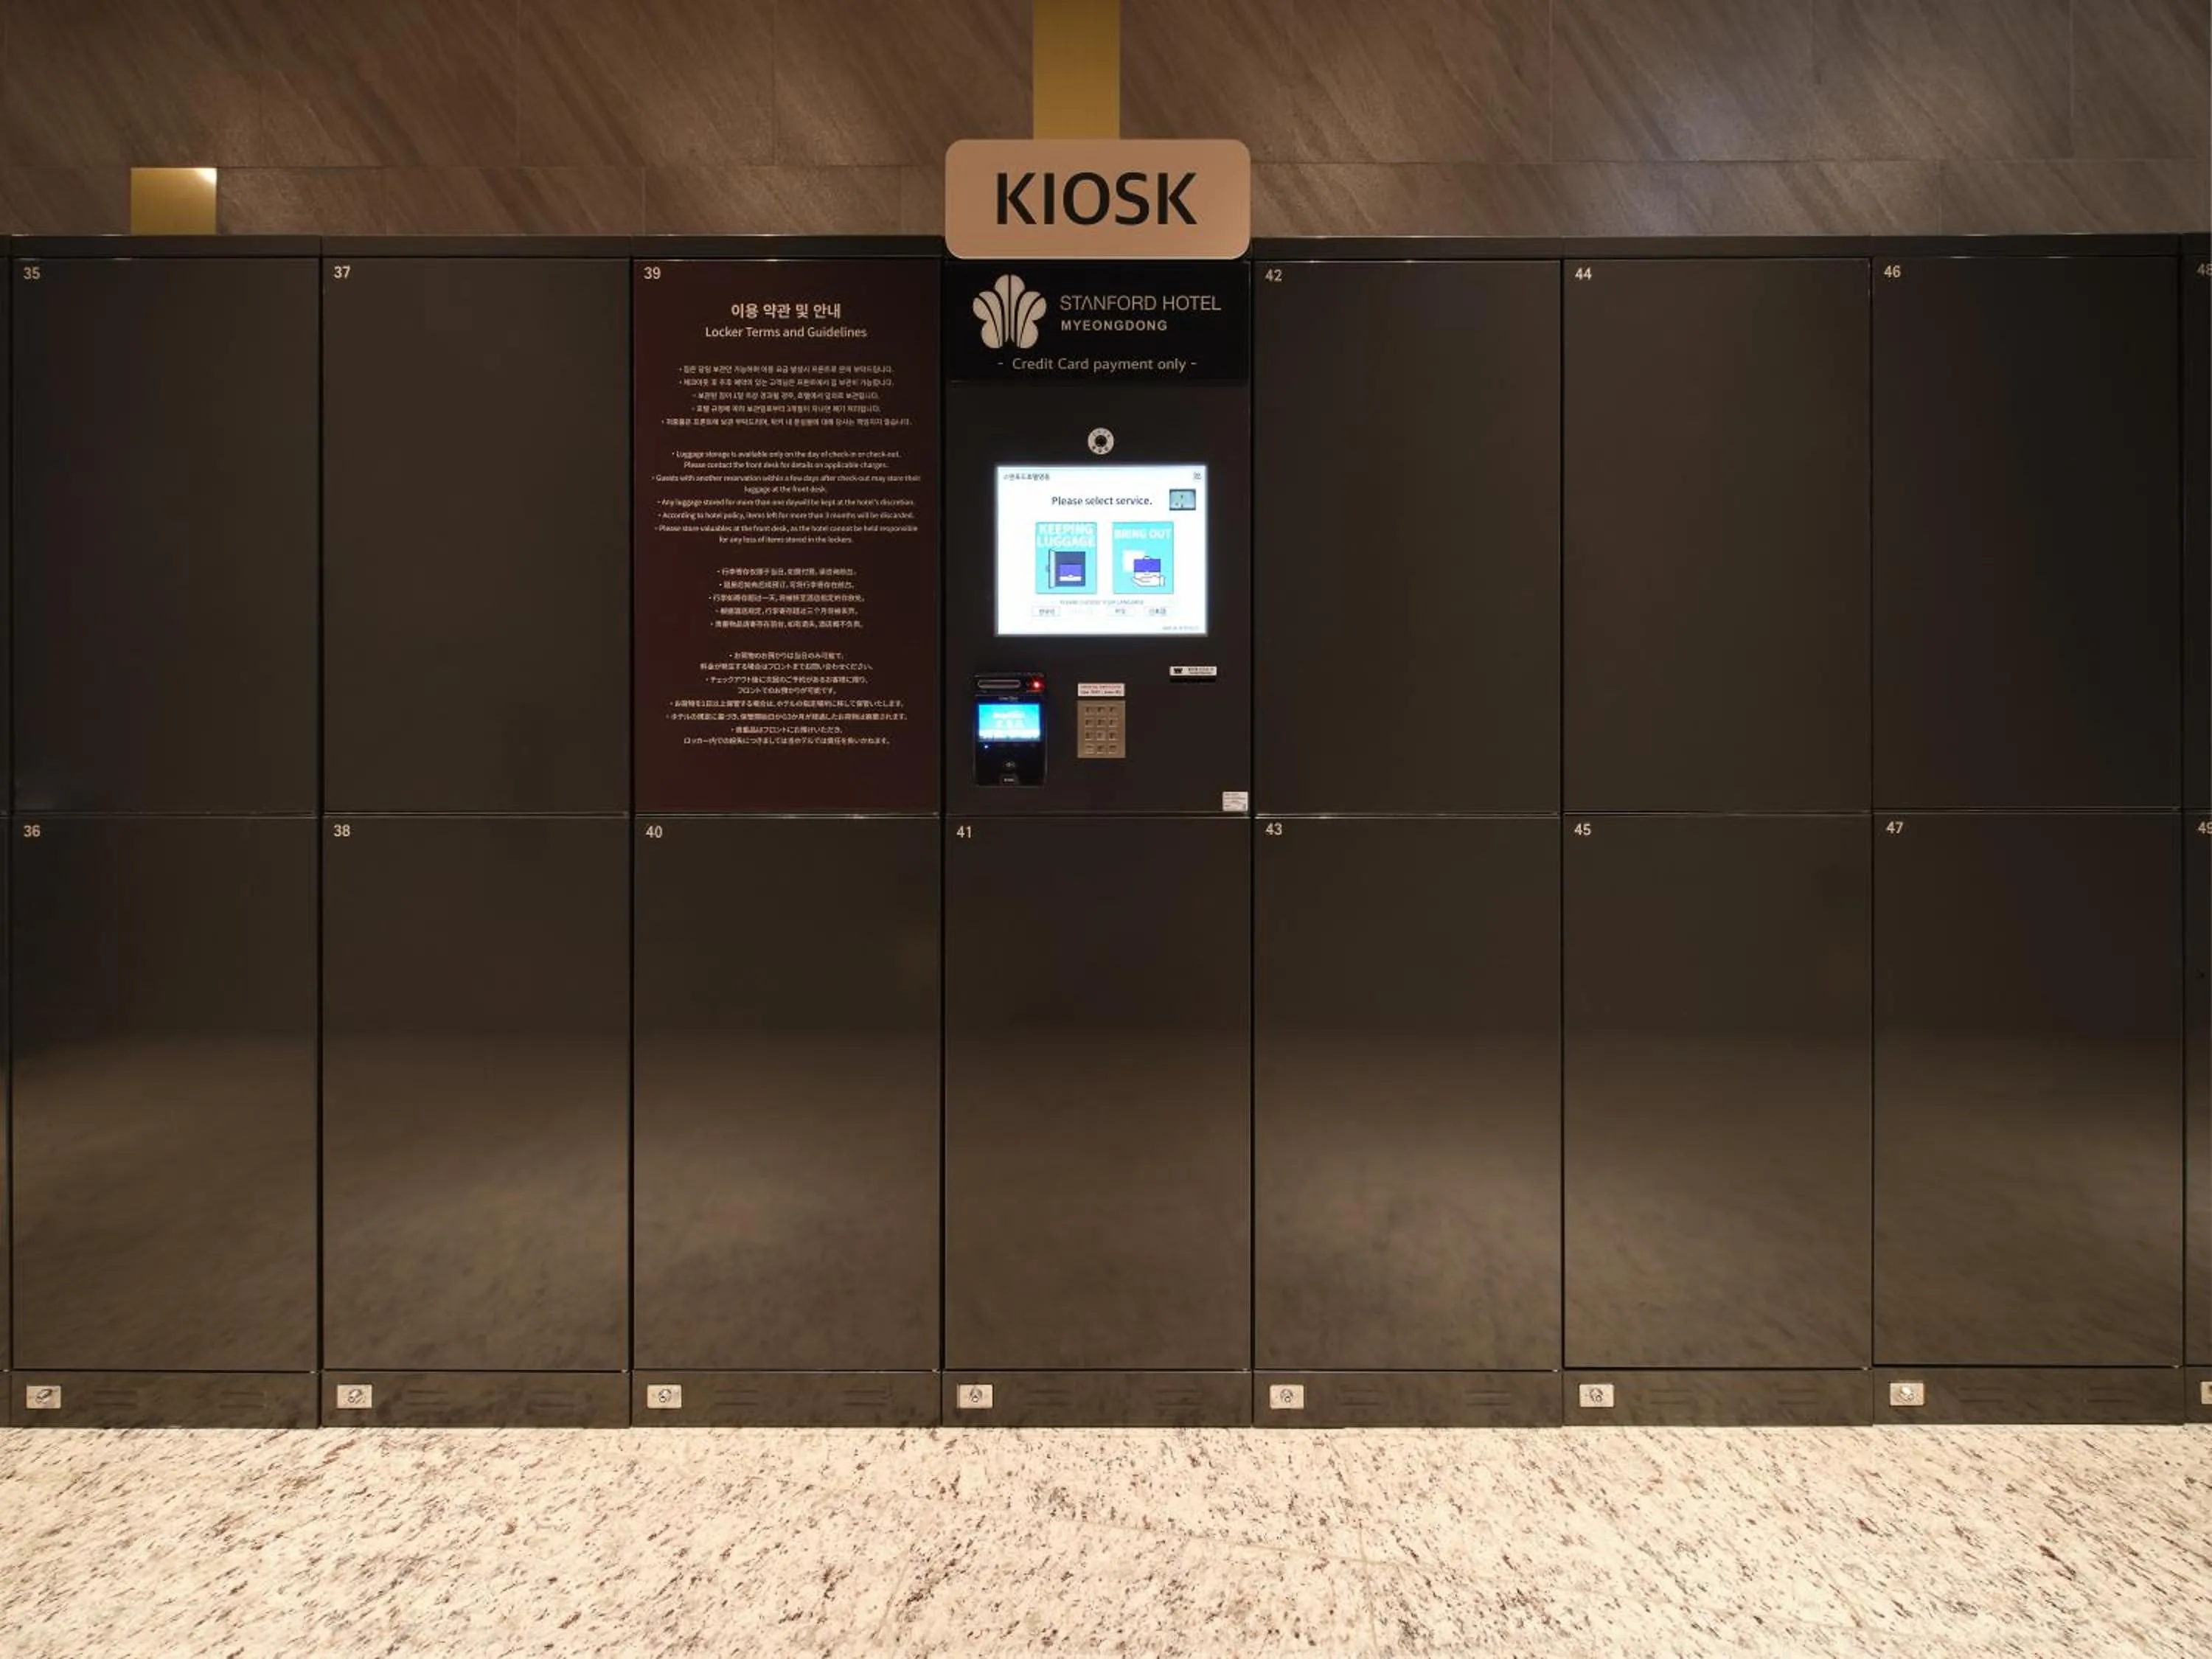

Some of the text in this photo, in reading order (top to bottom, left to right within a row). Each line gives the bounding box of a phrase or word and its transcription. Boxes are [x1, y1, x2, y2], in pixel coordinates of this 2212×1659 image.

[996, 172, 1197, 225] KIOSK
[23, 266, 41, 280] 35
[333, 265, 351, 279] 37
[643, 266, 661, 280] 39
[1265, 268, 1282, 282] 42
[1574, 267, 1593, 281] 44
[1883, 265, 1902, 278] 46
[1060, 294, 1222, 311] STANFORD HOTEL
[731, 303, 841, 319] 이용 약관 및 안내
[705, 326, 867, 338] Locker Terms and Guidelines
[1061, 319, 1167, 331] MYEONGDONG
[1012, 358, 1187, 374] Credit Card payment only
[1051, 496, 1152, 506] Please select service.
[1038, 524, 1093, 535] KEEPING
[1114, 529, 1172, 539] BRING OUT
[1037, 536, 1096, 547] LUGGAGE
[23, 824, 41, 838] 36
[333, 824, 351, 838] 38
[645, 825, 663, 838] 40
[956, 825, 973, 838] 41
[1265, 822, 1283, 836] 43
[1573, 822, 1592, 836] 45
[1885, 821, 1904, 834] 47
